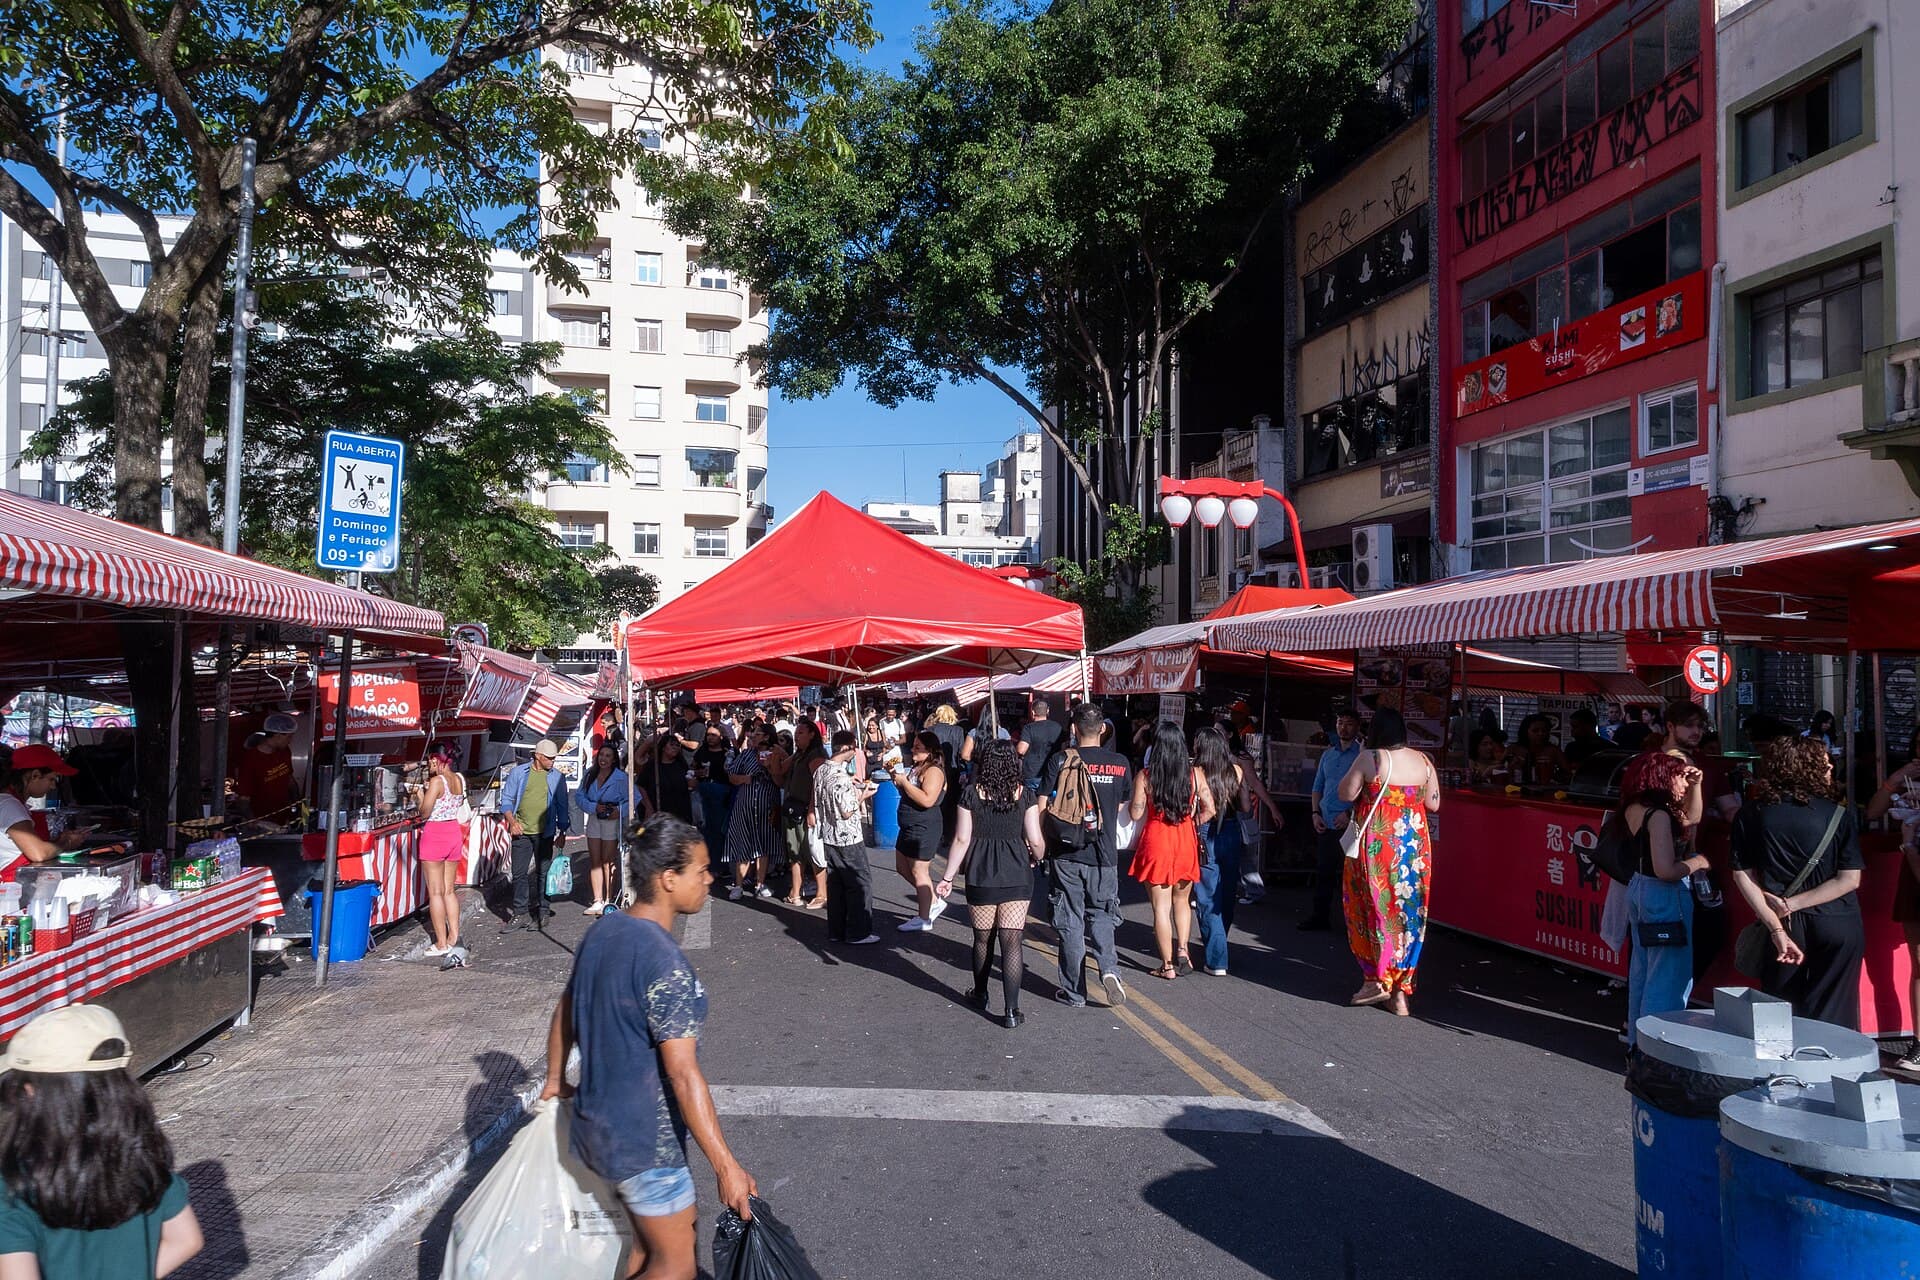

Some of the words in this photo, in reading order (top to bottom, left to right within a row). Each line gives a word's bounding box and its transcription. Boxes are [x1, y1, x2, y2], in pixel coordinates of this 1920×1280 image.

[1545, 348, 1575, 366] SUSHI
[331, 440, 354, 452] RUA
[356, 445, 397, 459] ABERTA
[333, 517, 387, 534] Domingo
[329, 534, 336, 542] e
[341, 533, 387, 547] Feriado
[364, 688, 376, 702] E
[420, 684, 466, 695] TEMPUR
[1542, 699, 1593, 711] TAPIOCAS
[1535, 889, 1583, 930] SUSHI
[1535, 929, 1587, 956] JAPANESE
[1592, 947, 1620, 966] FOOD
